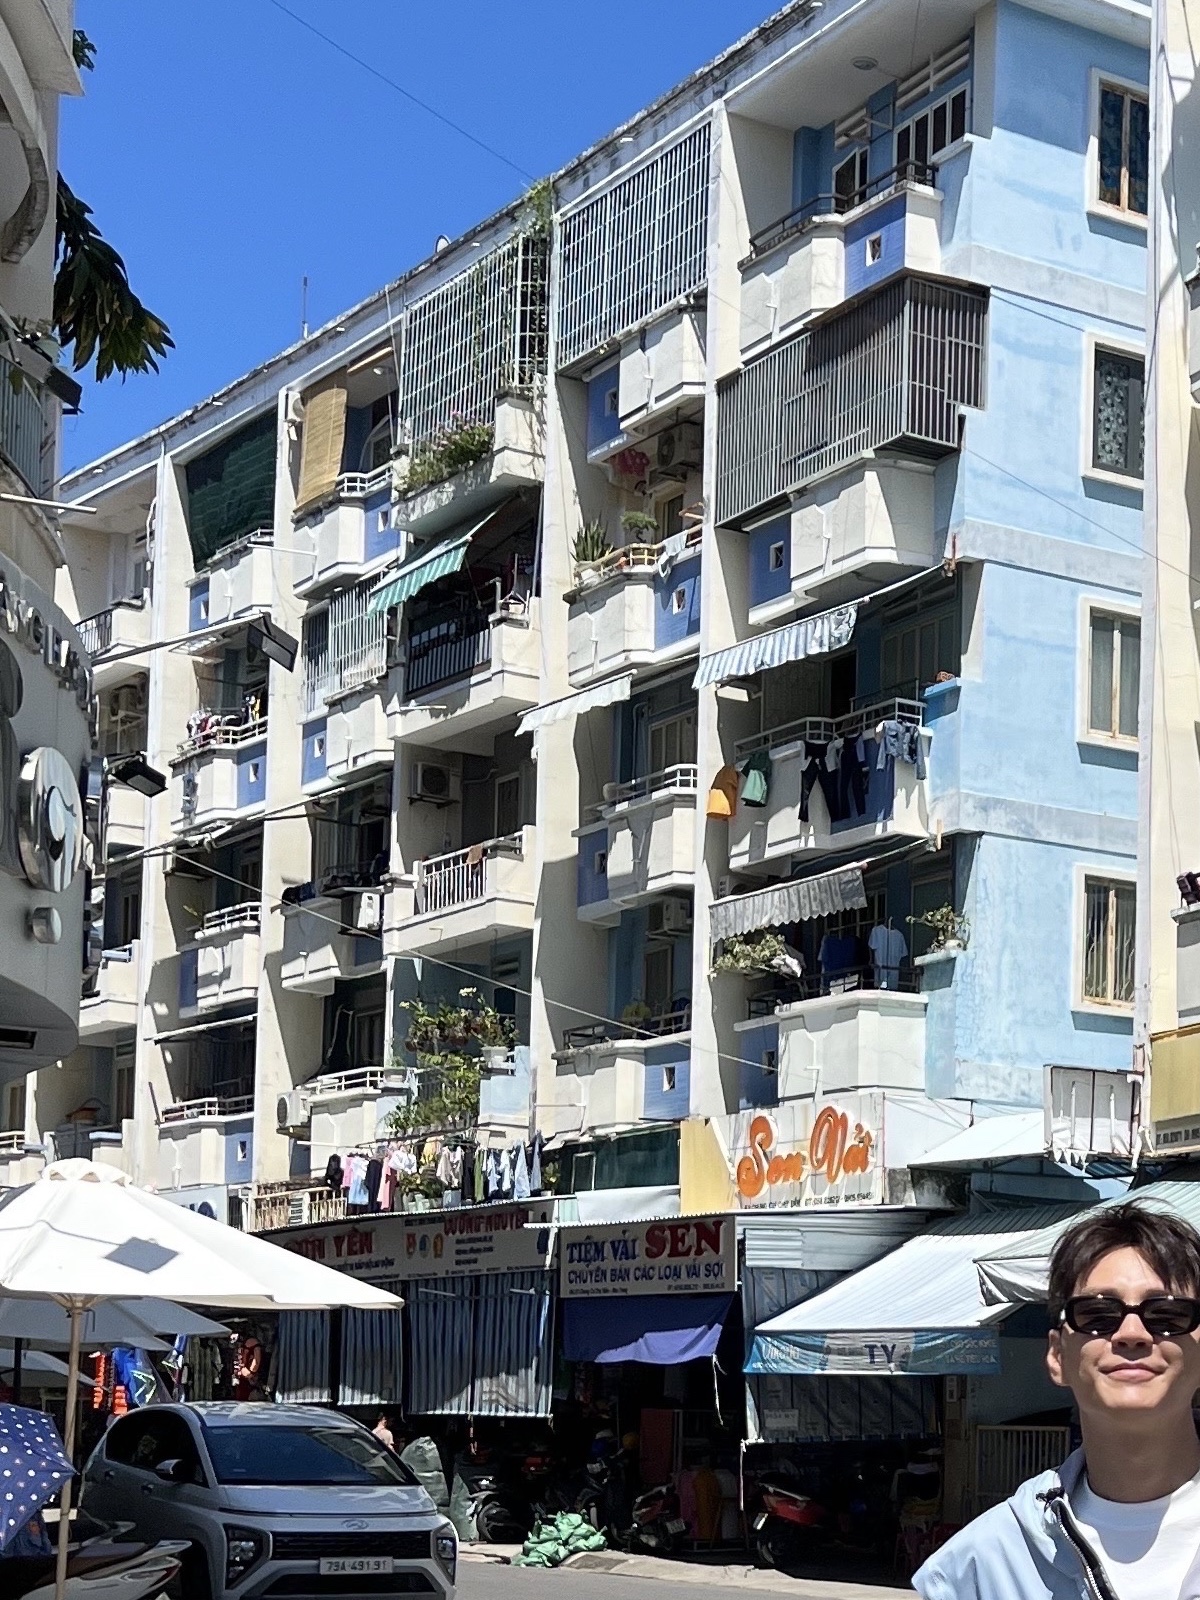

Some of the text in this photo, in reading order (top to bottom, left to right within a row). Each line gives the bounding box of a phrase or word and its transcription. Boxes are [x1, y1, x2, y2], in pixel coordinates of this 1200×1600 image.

[567, 1229, 638, 1268] TIỆM VẢI
[645, 1219, 727, 1259] SEN
[568, 1257, 725, 1285] CHUYÊN BÁN CÁC LOẠI VẢI SỢI
